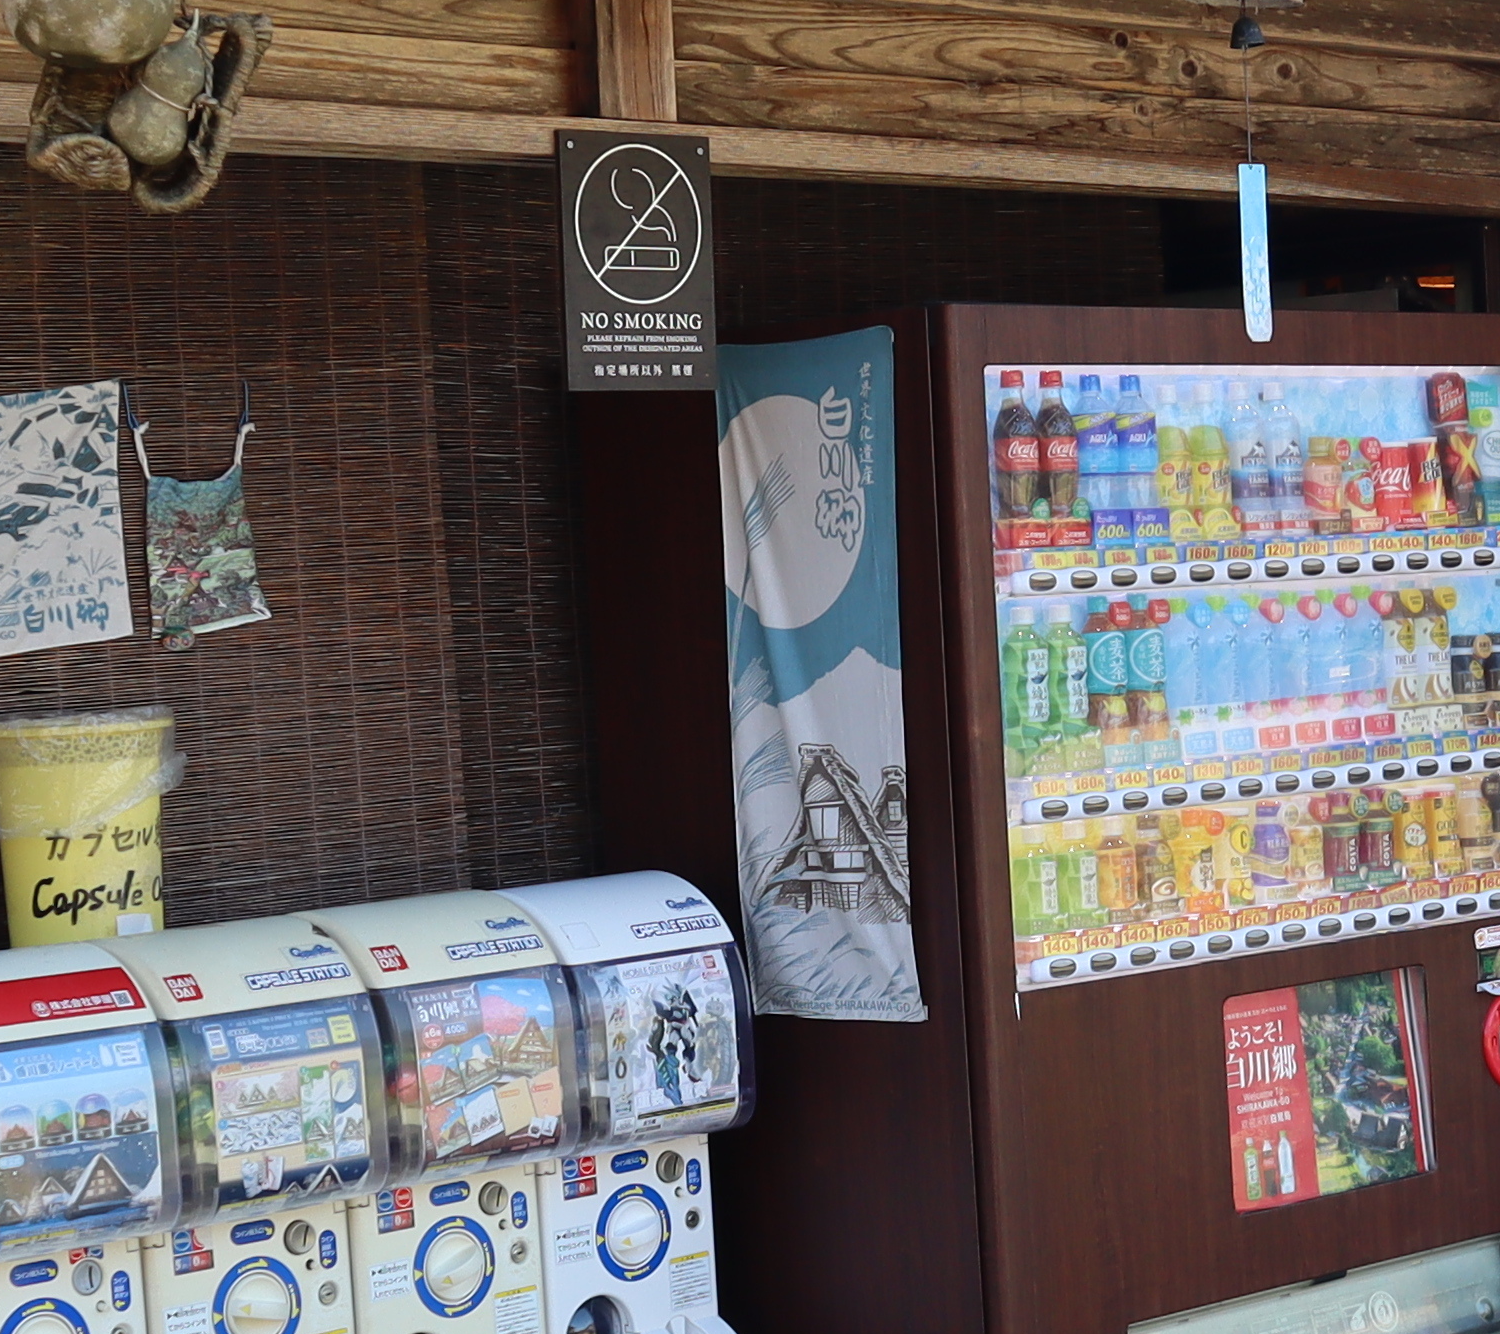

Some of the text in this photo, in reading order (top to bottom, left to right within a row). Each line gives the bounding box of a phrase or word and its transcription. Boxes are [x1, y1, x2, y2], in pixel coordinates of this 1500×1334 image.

[580, 312, 703, 330] NO SMOKING
[582, 345, 703, 353] OUTSIDE OF THE DESIGNATED AREAS
[587, 335, 698, 343] PLEASE REFRAIN FROM SMOKING
[858, 362, 875, 486] 世界文化遺産
[815, 385, 861, 552] 白川郷
[1266, 543, 1293, 555] 120円
[1300, 541, 1328, 554] 120円
[23, 596, 109, 633] 白川郷
[1108, 638, 1125, 681] 麦茶
[1147, 635, 1165, 677] 麦茶
[1349, 838, 1358, 872] COSTA
[1382, 833, 1391, 867] COSTA
[32, 870, 143, 925] Capsule
[793, 999, 911, 1014] Heritage SHIRAKAWA-GO
[1227, 1018, 1284, 1050] ようこそ!
[1226, 1043, 1298, 1089] 白川郷
[1236, 1095, 1290, 1114] SHIRAKAWA-GO
[1242, 1087, 1284, 1102] Welcome To
